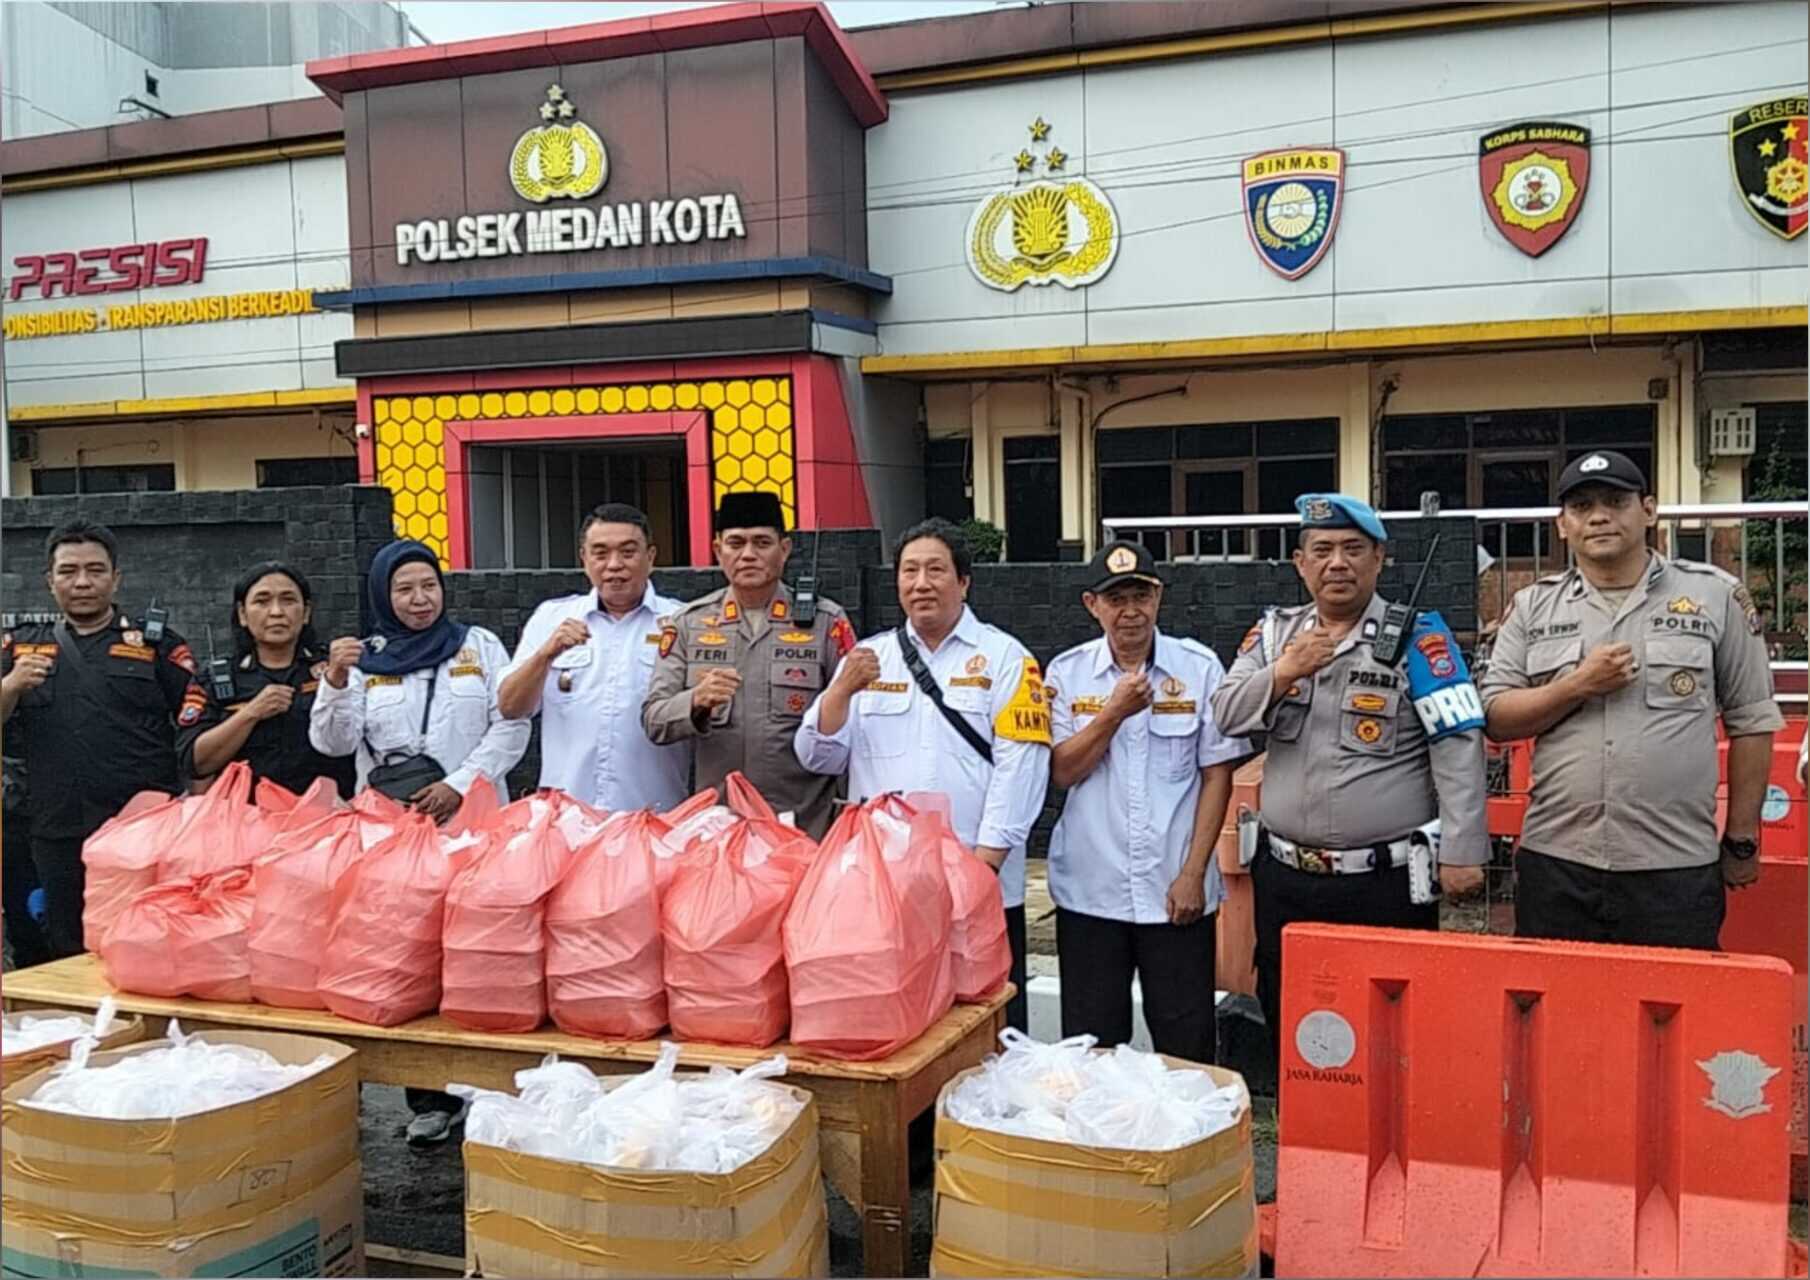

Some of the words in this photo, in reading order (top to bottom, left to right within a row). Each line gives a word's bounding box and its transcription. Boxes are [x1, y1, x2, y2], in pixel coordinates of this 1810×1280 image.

[1749, 99, 1808, 124] RESER
[1485, 129, 1527, 150] KORPS
[1254, 155, 1330, 176] BINMAS
[396, 211, 522, 265] POLSEK
[526, 203, 642, 253] MEDAN
[649, 193, 745, 244] KOTA
[10, 237, 209, 300] PRESISI
[3, 308, 98, 340] ONSIBILITAS
[1653, 617, 1710, 632] POLRI
[694, 650, 728, 661] FERI
[774, 648, 818, 660] POLRI
[1349, 670, 1399, 688] POLRI
